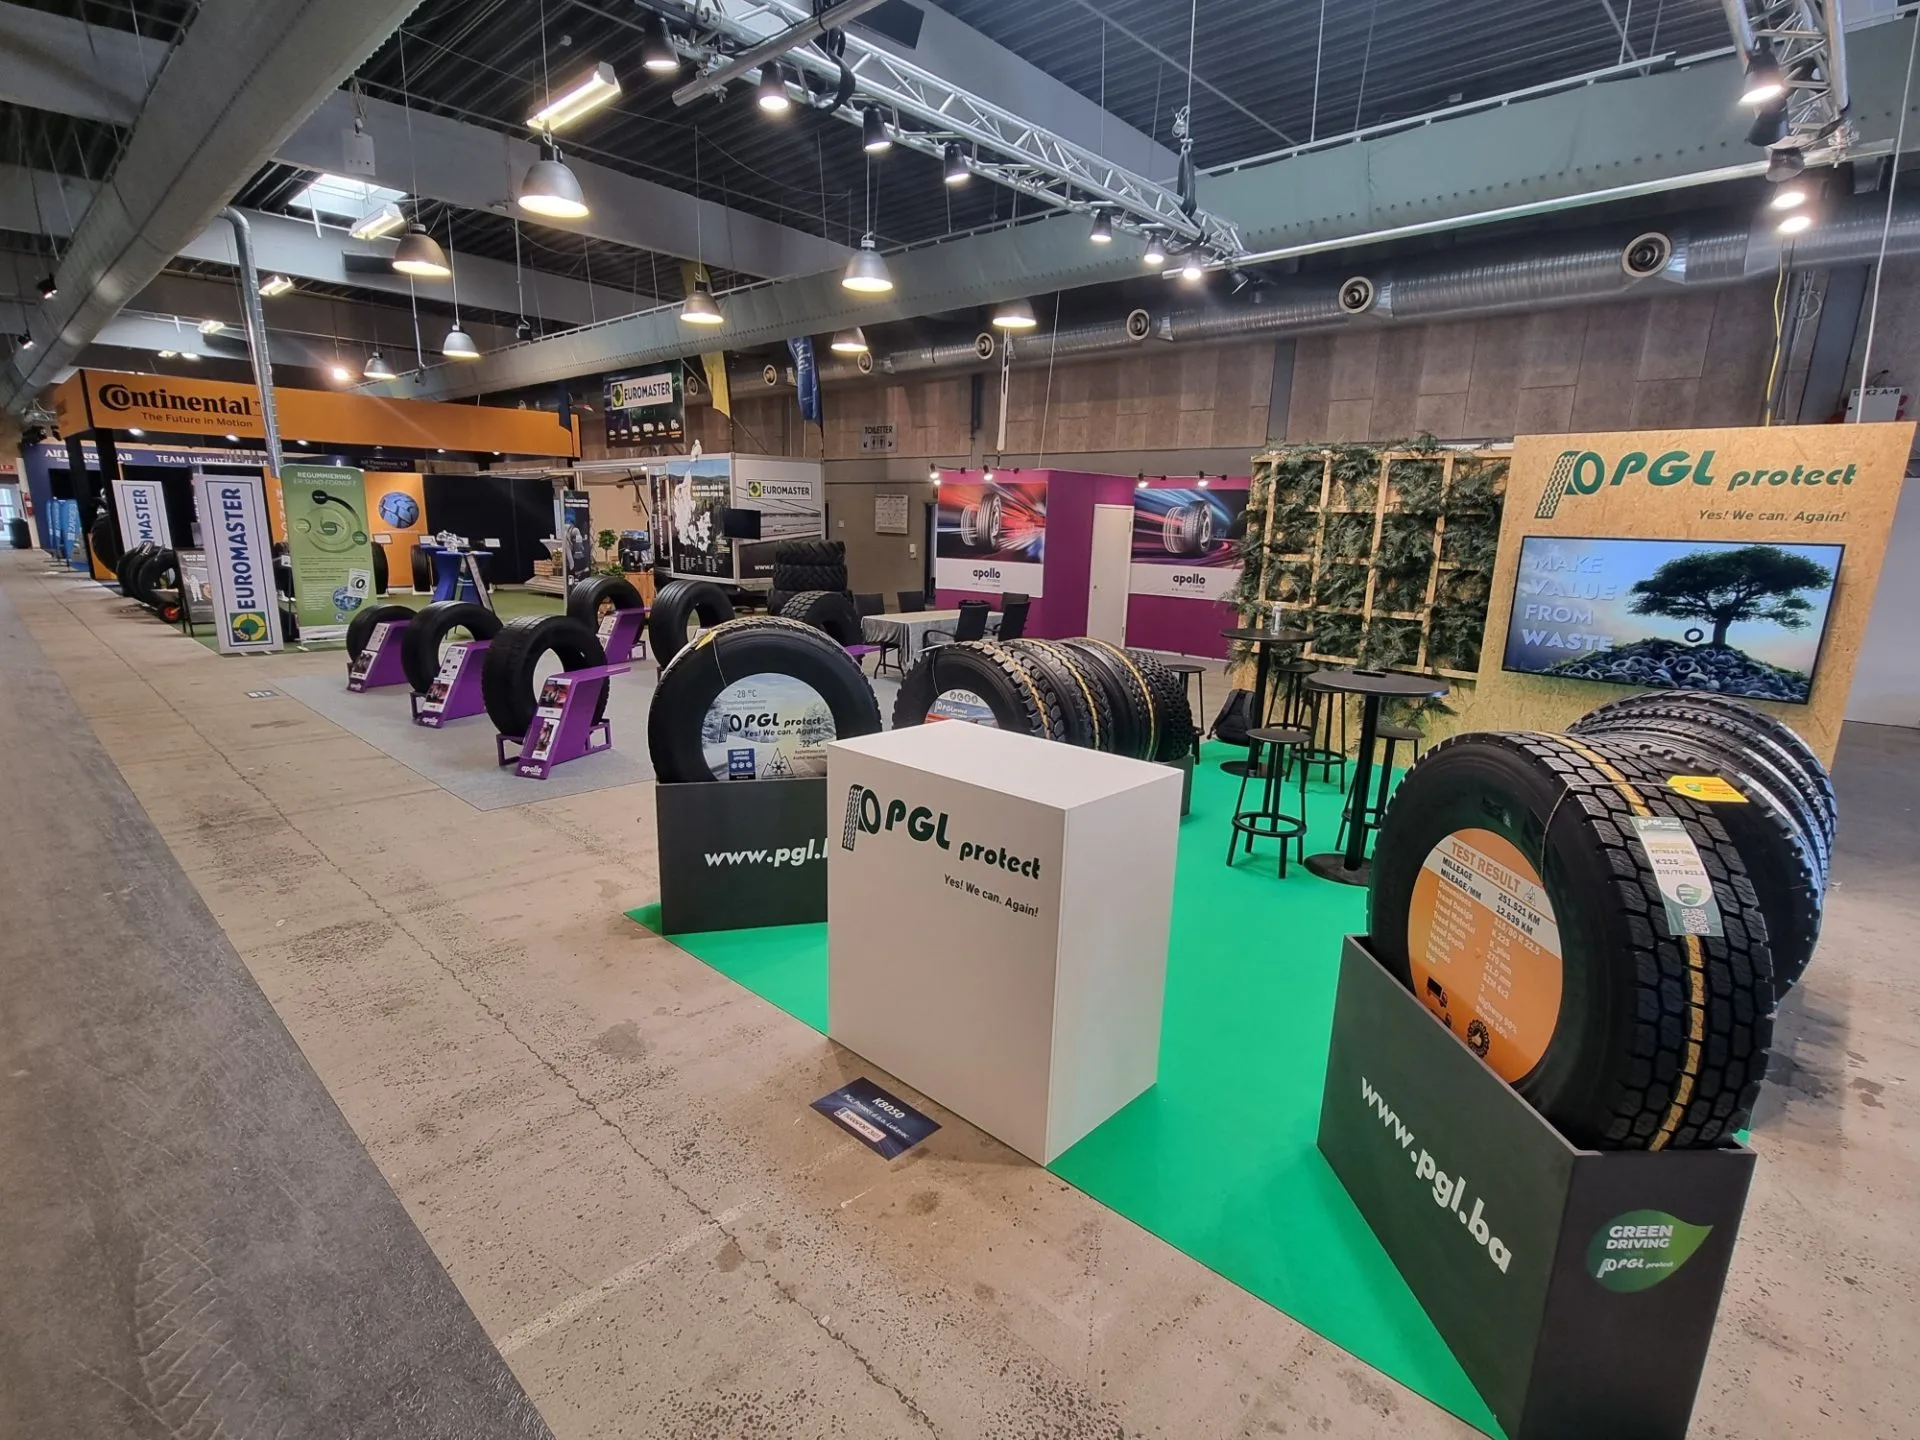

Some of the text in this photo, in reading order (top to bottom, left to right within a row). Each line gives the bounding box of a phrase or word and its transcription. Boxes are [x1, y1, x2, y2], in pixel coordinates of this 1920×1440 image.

[98, 384, 252, 416] Continental
[624, 382, 670, 400] EUROMASTER
[142, 412, 162, 422] The
[166, 415, 201, 424] Future
[216, 418, 252, 428] Motion
[864, 426, 892, 434] TOILETTER
[156, 455, 184, 464] TEAM
[1610, 450, 1857, 491] PGL protect
[762, 486, 810, 495] EUROMASTER
[132, 489, 155, 545] MASTER
[1699, 510, 1728, 521] Yes!
[1732, 509, 1754, 521] We
[1793, 512, 1847, 524] Again!
[222, 488, 256, 609] EUROMASTER
[972, 568, 1001, 580] apollo
[1535, 556, 1604, 574] MAKE
[1172, 573, 1206, 586] apollo
[1531, 580, 1617, 600] VALUE
[1525, 604, 1594, 624] FROM
[1522, 629, 1614, 652] WASTE
[732, 689, 746, 698] -28
[744, 712, 822, 728] PGL protect
[744, 730, 760, 738] Yes!
[796, 728, 821, 736] Again!
[522, 765, 542, 774] apollo
[885, 799, 1041, 880] PGL protect
[1442, 856, 1473, 882] MILLEAGE
[1452, 842, 1521, 894] TEST RESULT
[1440, 868, 1482, 900] MILEAGE/MM
[944, 874, 1040, 918] Yes! We can. Again!
[1498, 892, 1541, 926] 251.521 KM
[1496, 904, 1534, 936] 12.639 KM
[872, 1097, 906, 1119] K8050
[1361, 1076, 1512, 1276] www.pgl.ba
[1609, 1225, 1674, 1238] GREEN
[1606, 1238, 1671, 1250] DRIVING
[1617, 1258, 1644, 1269] PGL
